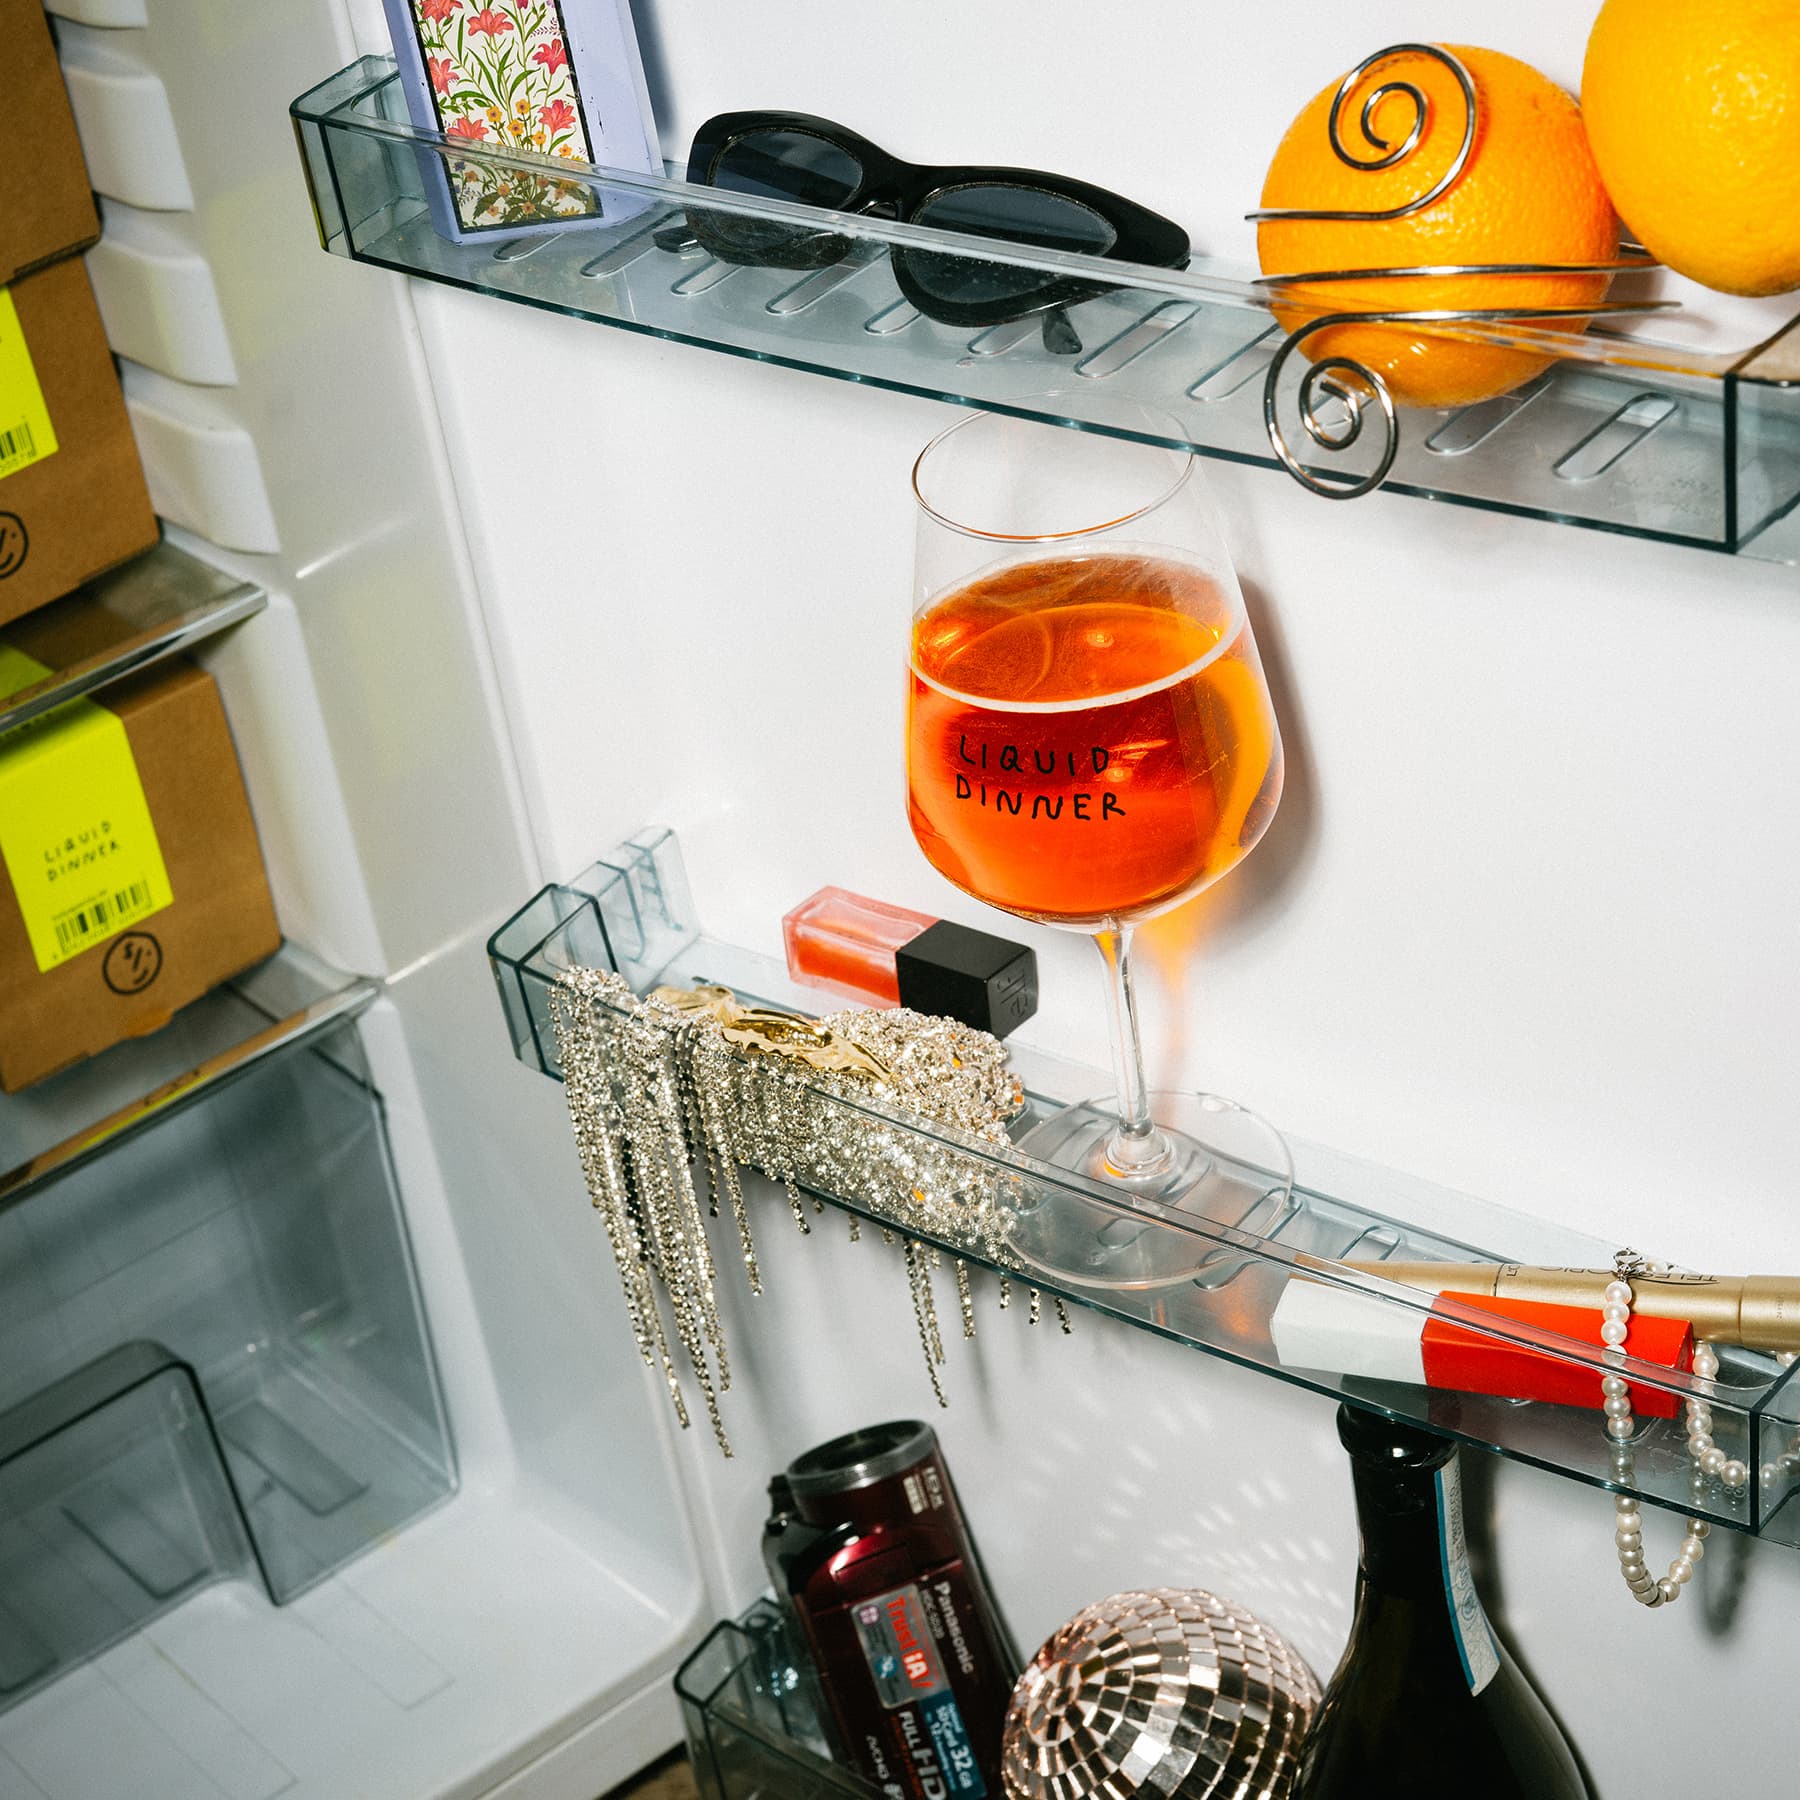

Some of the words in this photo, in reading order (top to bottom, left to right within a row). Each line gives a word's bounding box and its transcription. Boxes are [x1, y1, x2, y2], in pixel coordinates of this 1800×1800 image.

[959, 734, 1109, 776] LIQUID
[956, 773, 1126, 821] DINNER
[44, 820, 111, 863] LIQUID
[47, 840, 118, 882] DINNER
[886, 1596, 919, 1651] Trust
[934, 1581, 975, 1675] Panasonic
[899, 1711, 922, 1749] FULL
[911, 1747, 948, 1800] HD
